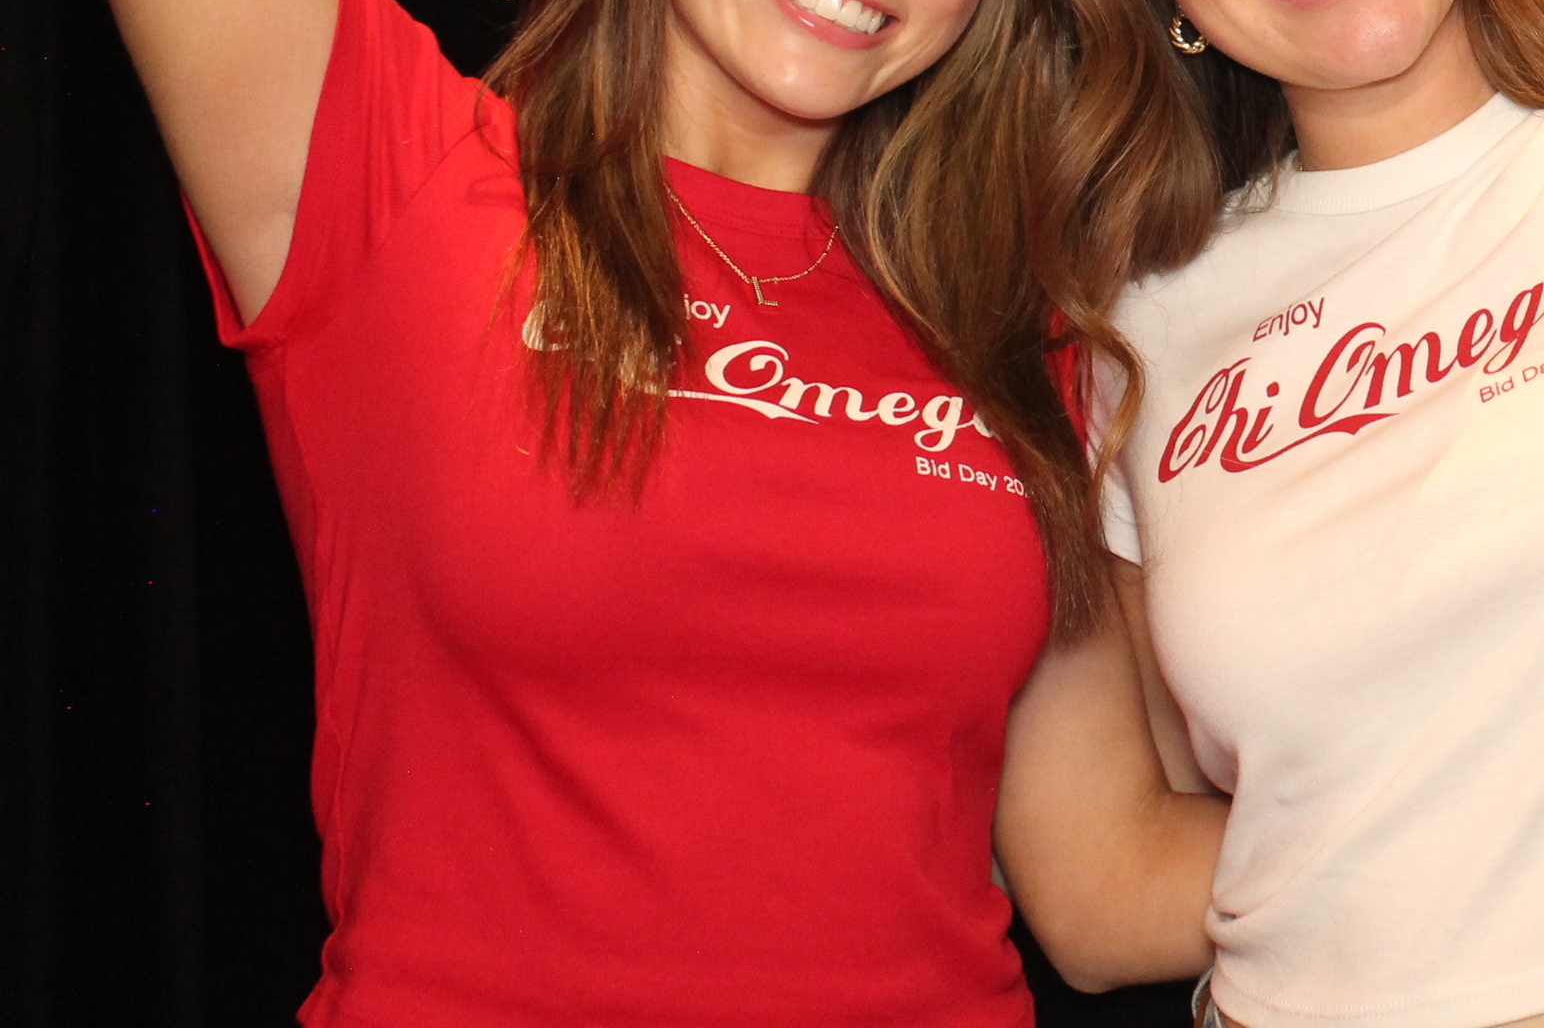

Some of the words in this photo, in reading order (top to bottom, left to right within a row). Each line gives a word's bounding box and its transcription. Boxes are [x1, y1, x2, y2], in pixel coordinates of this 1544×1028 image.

[683, 293, 730, 328] joy
[1252, 297, 1326, 342] Enjoy
[704, 339, 996, 452] Omeg
[1479, 376, 1515, 403] Bid
[1158, 357, 1281, 483] Chi
[915, 456, 951, 480] Bid
[958, 463, 998, 491] Day
[1003, 475, 1033, 499] 20
